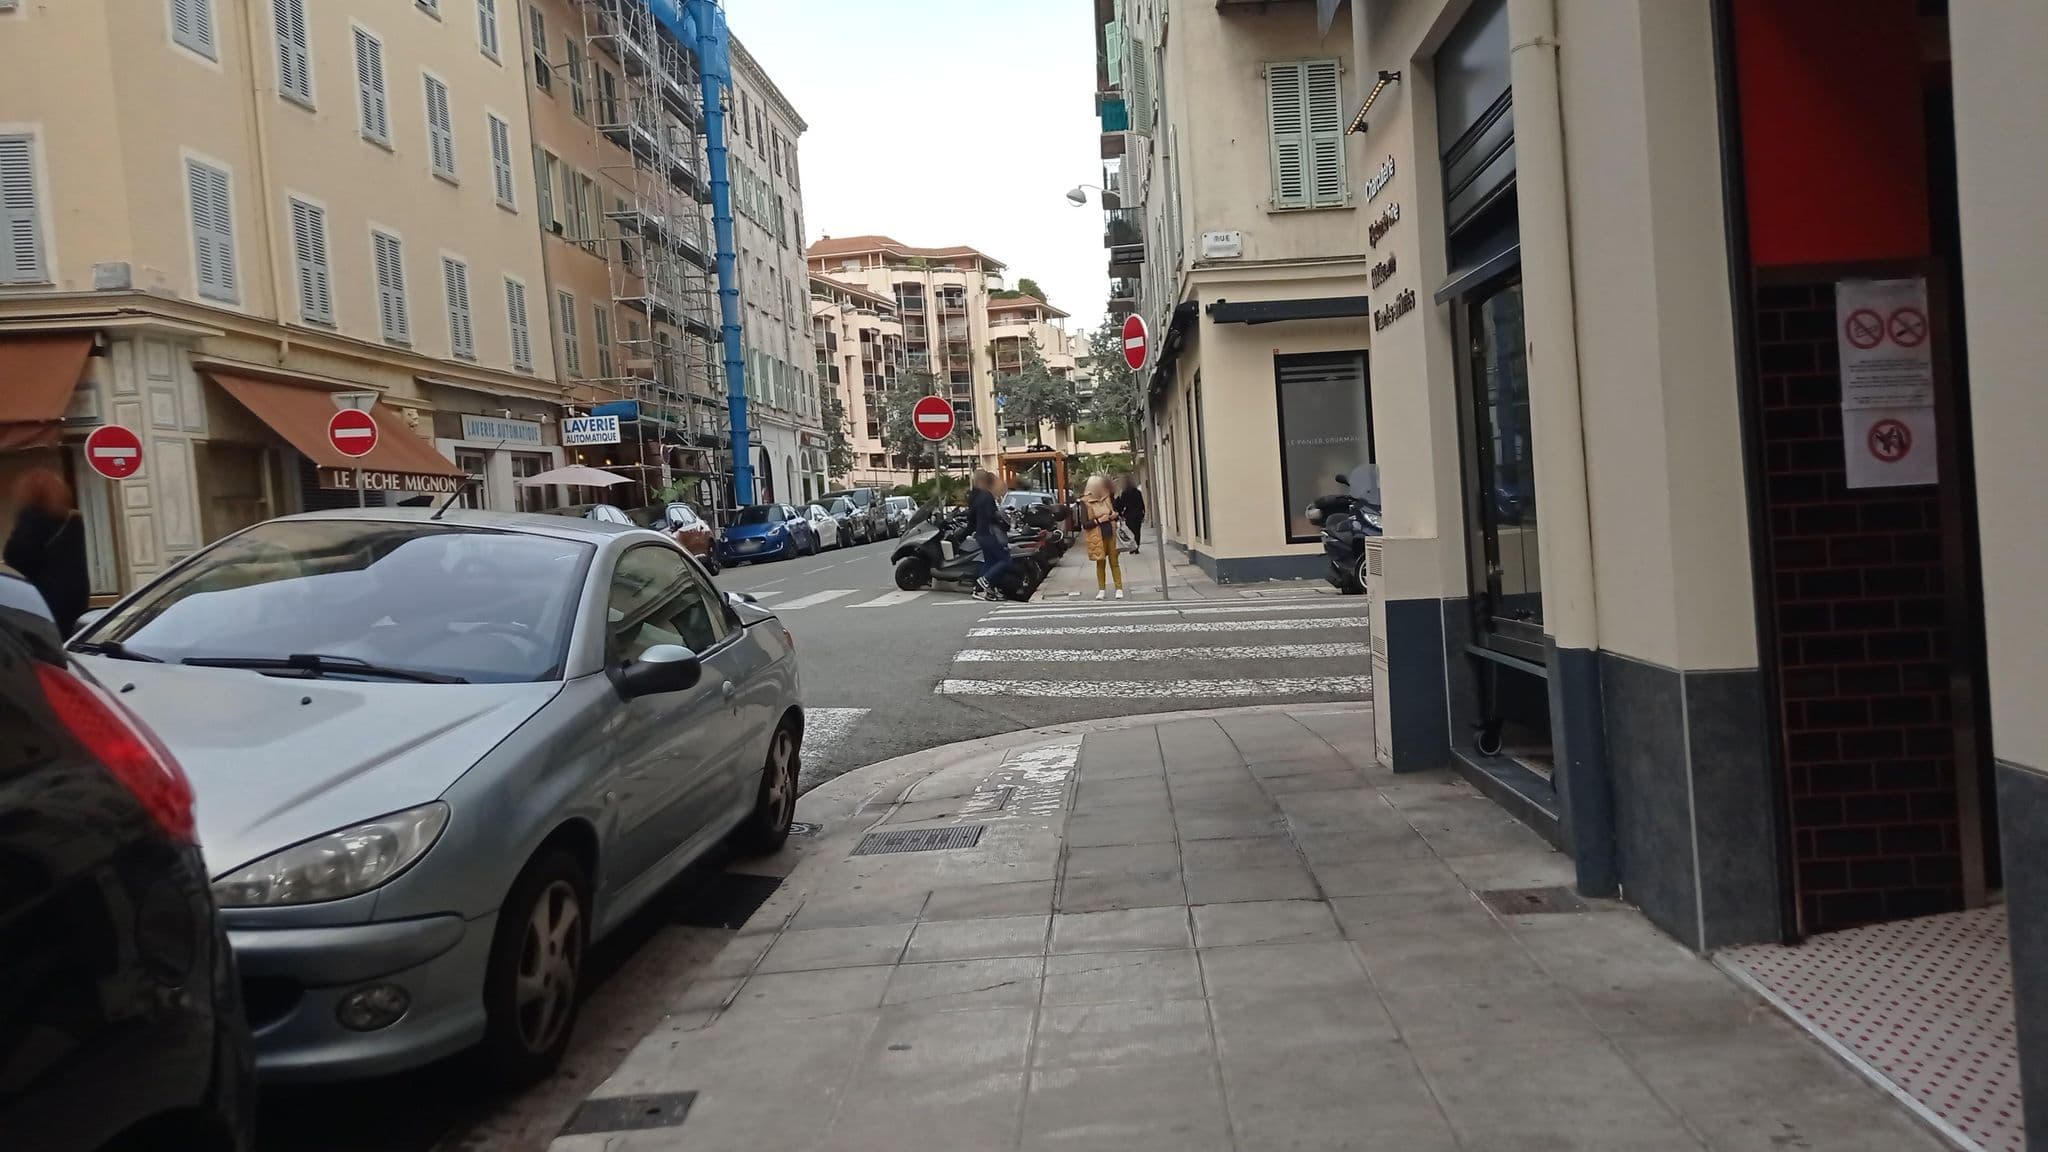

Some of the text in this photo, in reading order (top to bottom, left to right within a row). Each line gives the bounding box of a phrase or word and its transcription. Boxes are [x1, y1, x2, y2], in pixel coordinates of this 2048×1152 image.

[467, 420, 538, 441] LAVERIE AUTOMATIQUE
[564, 418, 616, 434] LAVERIE
[566, 432, 617, 444] AUTOMATIQUE
[334, 470, 350, 488] LE
[405, 475, 457, 492] MIGNON
